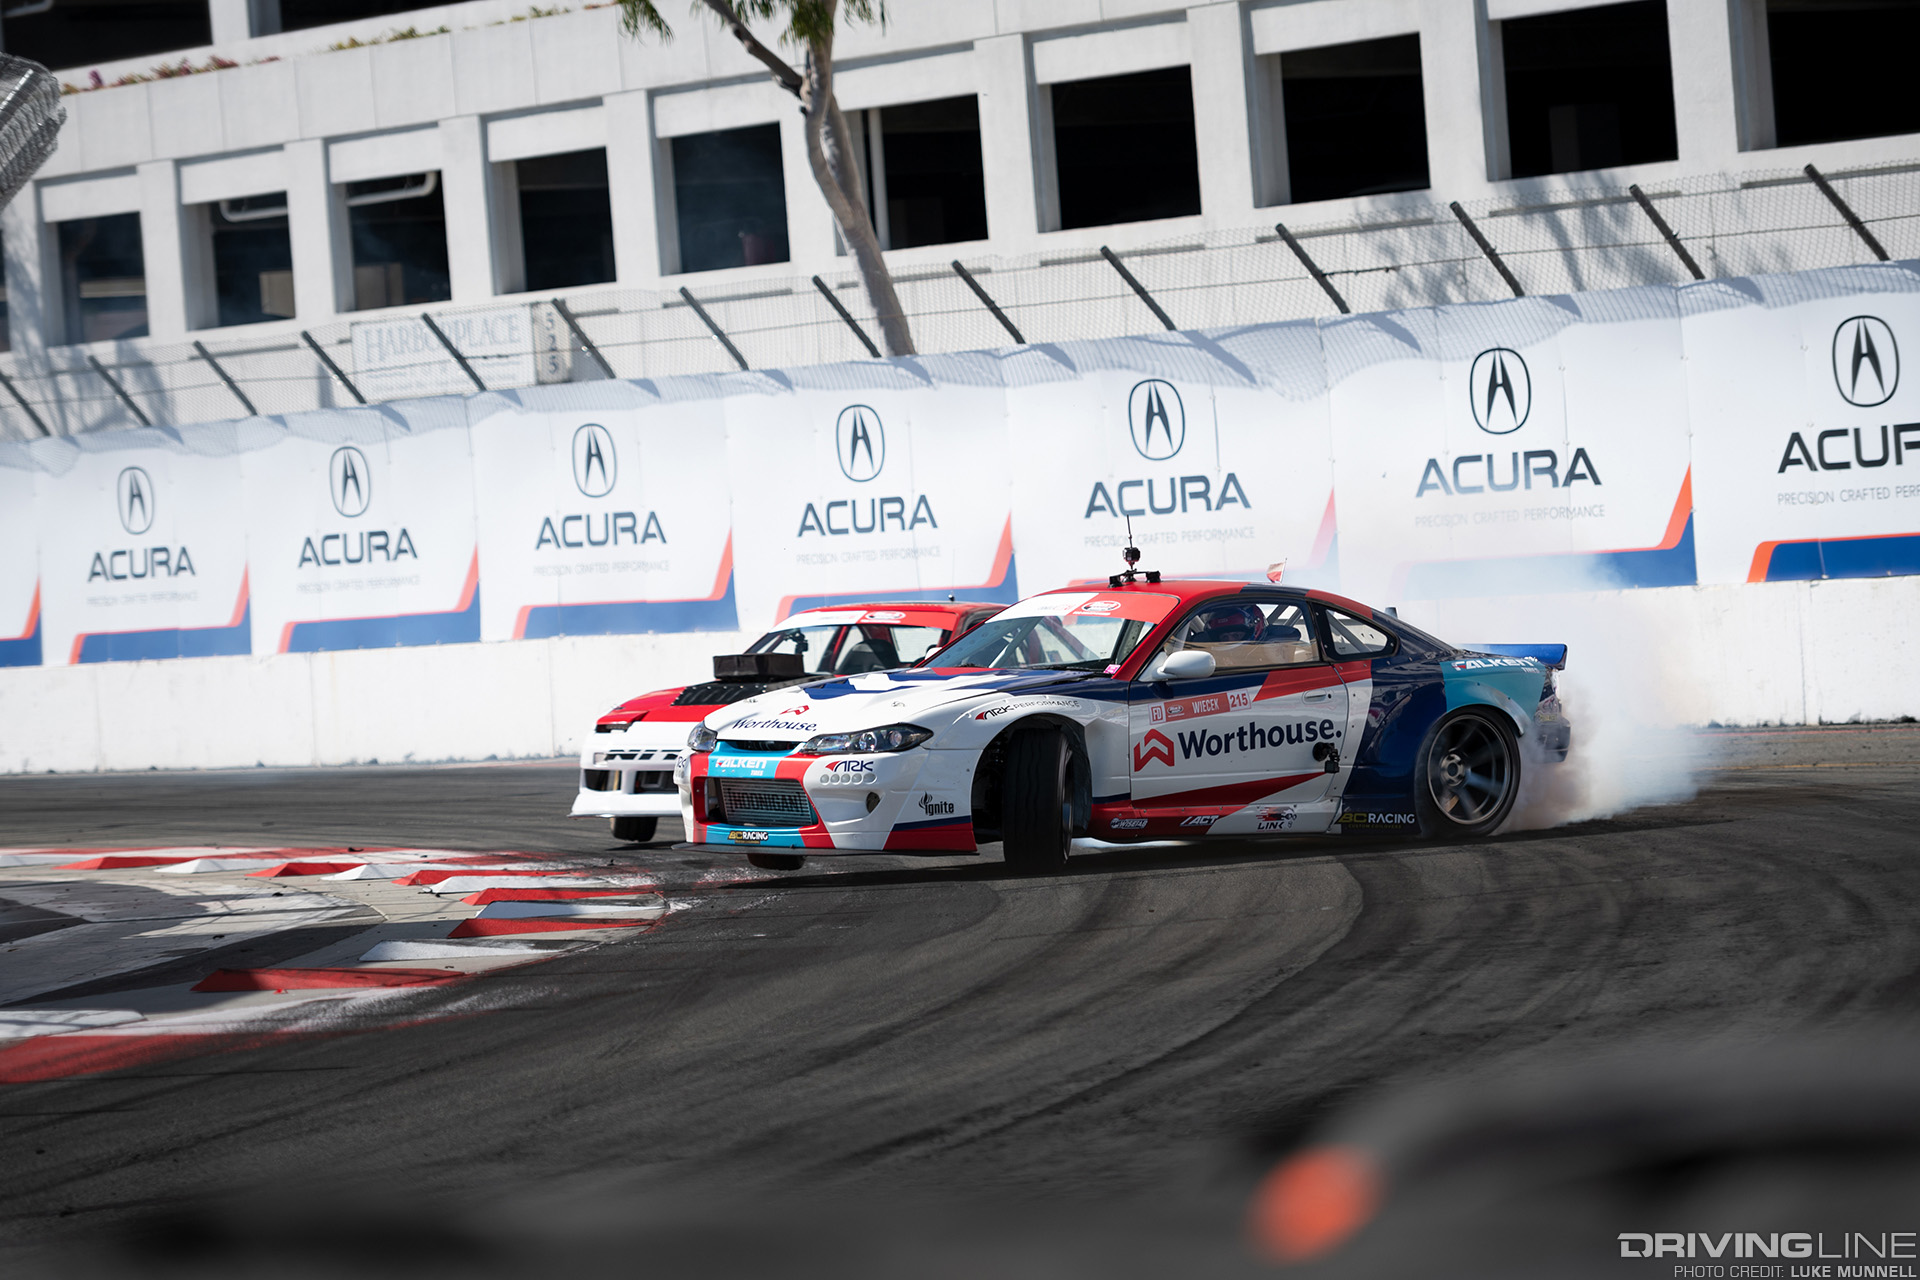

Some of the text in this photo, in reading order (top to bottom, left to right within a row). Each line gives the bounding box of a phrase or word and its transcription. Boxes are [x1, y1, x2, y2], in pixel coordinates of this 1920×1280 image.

[1415, 447, 1602, 498] ACURA
[1084, 472, 1252, 519] ACURA
[1777, 491, 1834, 506] PRECISION
[1840, 486, 1890, 502] CRAFTED
[797, 494, 938, 538] ACURA
[1415, 503, 1606, 528] PRECISION CRAFTED PERFORMANCE
[535, 511, 668, 550] ACURA
[1181, 525, 1256, 542] PERFORMANCE
[297, 527, 418, 569] ACURA
[87, 546, 196, 582] ACURA
[1451, 657, 1535, 671] FALKEN
[1014, 699, 1080, 710] PERFORMANCE
[1191, 698, 1220, 715] WIECEK
[1229, 693, 1249, 708] 215
[732, 718, 818, 732] Worthouse.
[1177, 718, 1342, 760] Worthouse.
[715, 758, 767, 769] FALKEN
[828, 760, 874, 772] ARK
[924, 800, 955, 816] ignite
